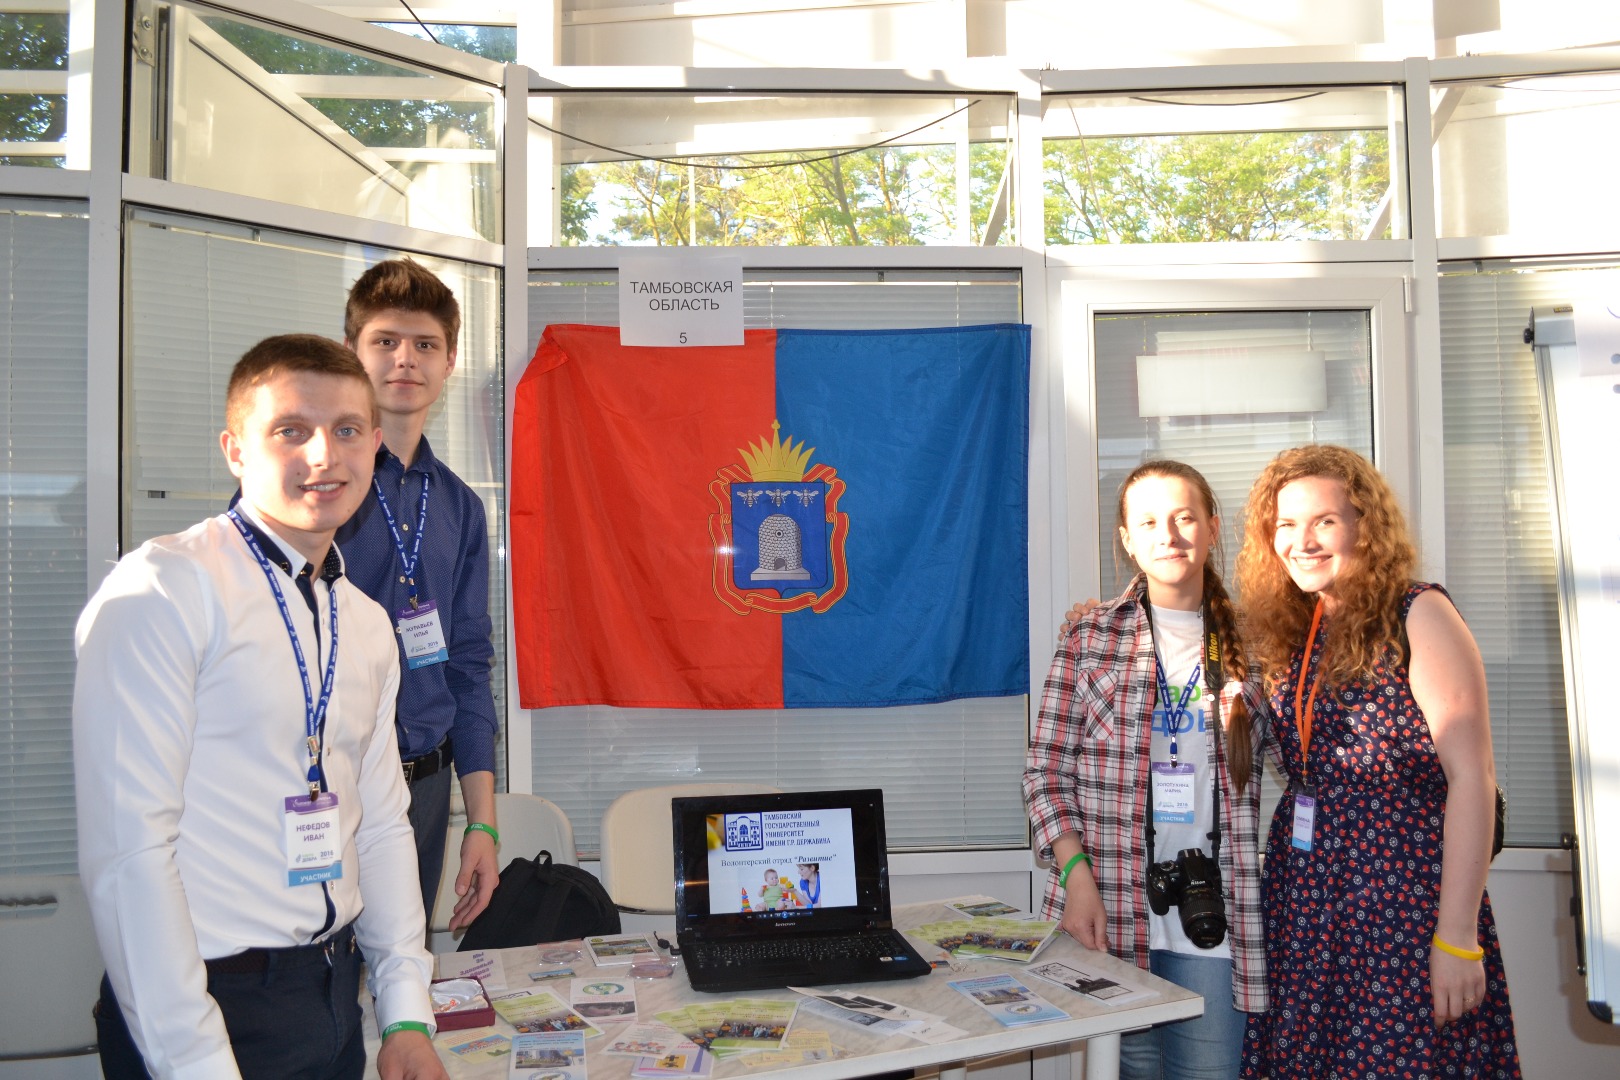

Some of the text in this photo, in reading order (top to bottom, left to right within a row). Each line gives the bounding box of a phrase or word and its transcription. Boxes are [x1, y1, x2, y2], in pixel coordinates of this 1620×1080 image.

[630, 281, 733, 294] ТАМБОВСКАЯ
[649, 298, 720, 311] ОБЛАСТЬ
[679, 332, 688, 344] 5
[1209, 632, 1219, 662] Nikon
[763, 812, 802, 821] ТАМБОВСКИЙ
[296, 821, 331, 832] НЕФЕДОВ
[764, 820, 820, 829] ГОСУДАРСТВЕННЫЙ
[303, 833, 325, 842] ИВАН
[765, 830, 805, 838] УНИВЕРСИТЕТ
[765, 839, 786, 847] ИМЕНИ
[796, 837, 831, 846] ДЕРЖАВИНА
[772, 857, 793, 866] отряд
[300, 872, 332, 882] УЧАСТНИК
